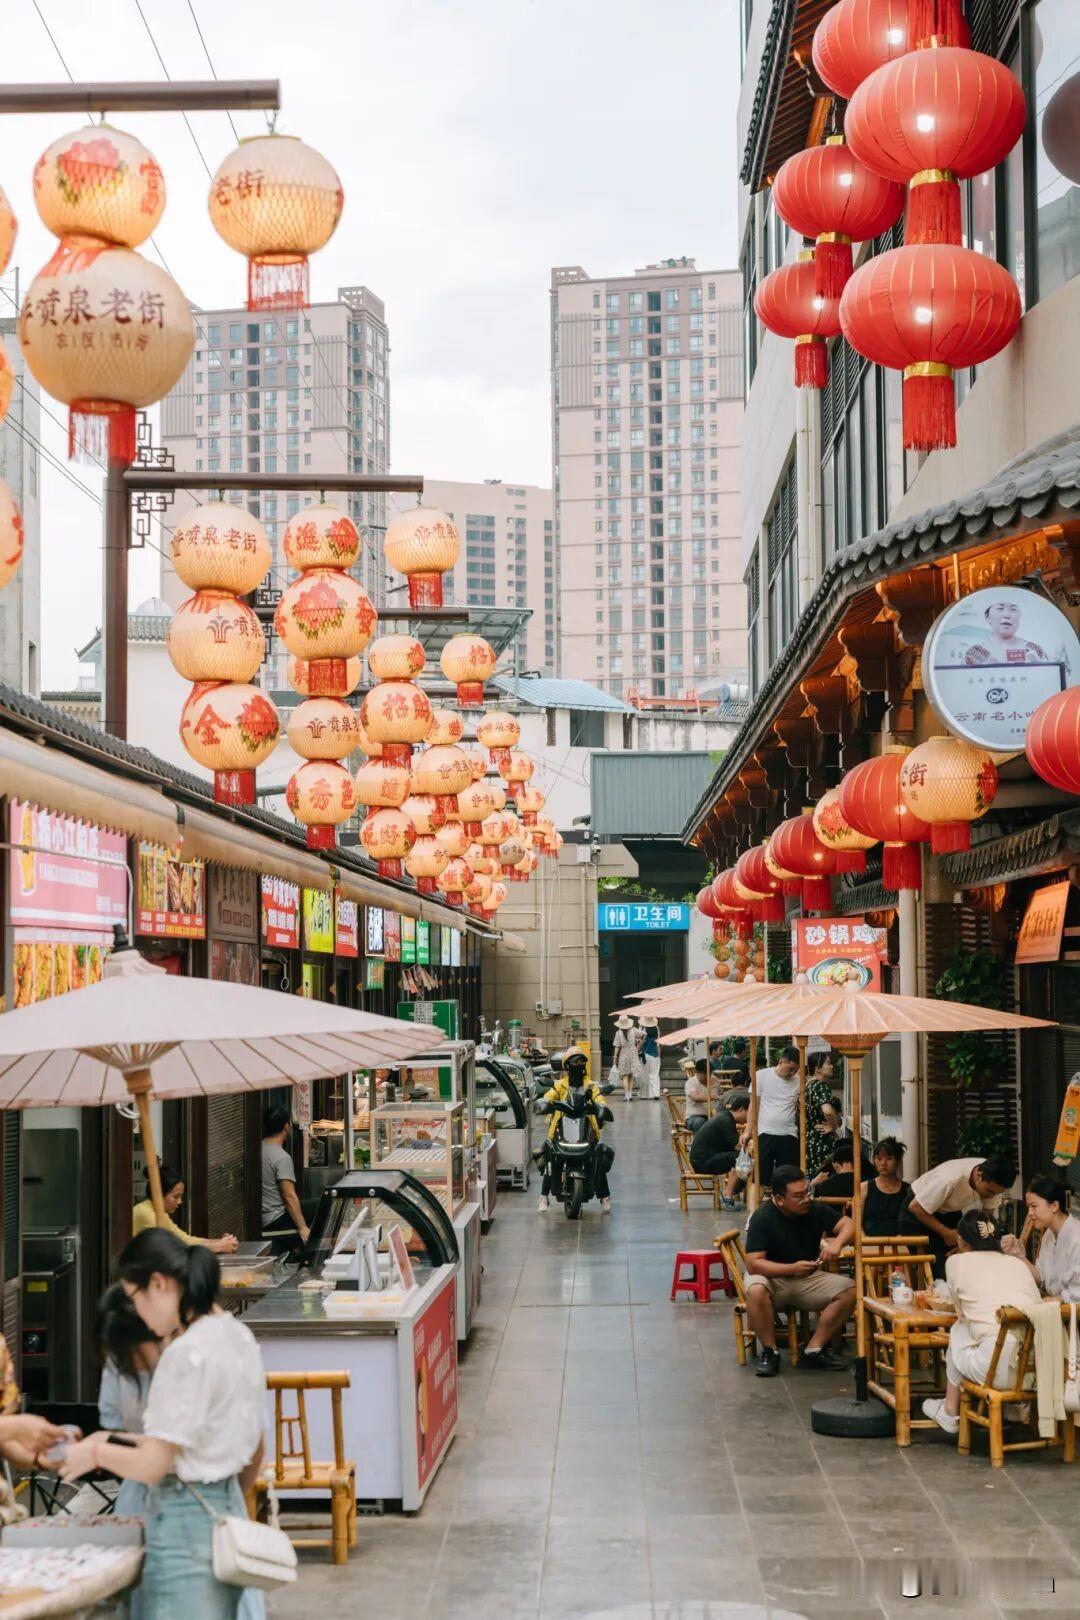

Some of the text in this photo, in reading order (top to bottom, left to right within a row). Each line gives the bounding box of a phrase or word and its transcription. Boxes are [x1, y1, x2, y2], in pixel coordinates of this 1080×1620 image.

[215, 169, 265, 206] 老街
[193, 703, 232, 746] 金
[633, 905, 682, 921] 卫生间
